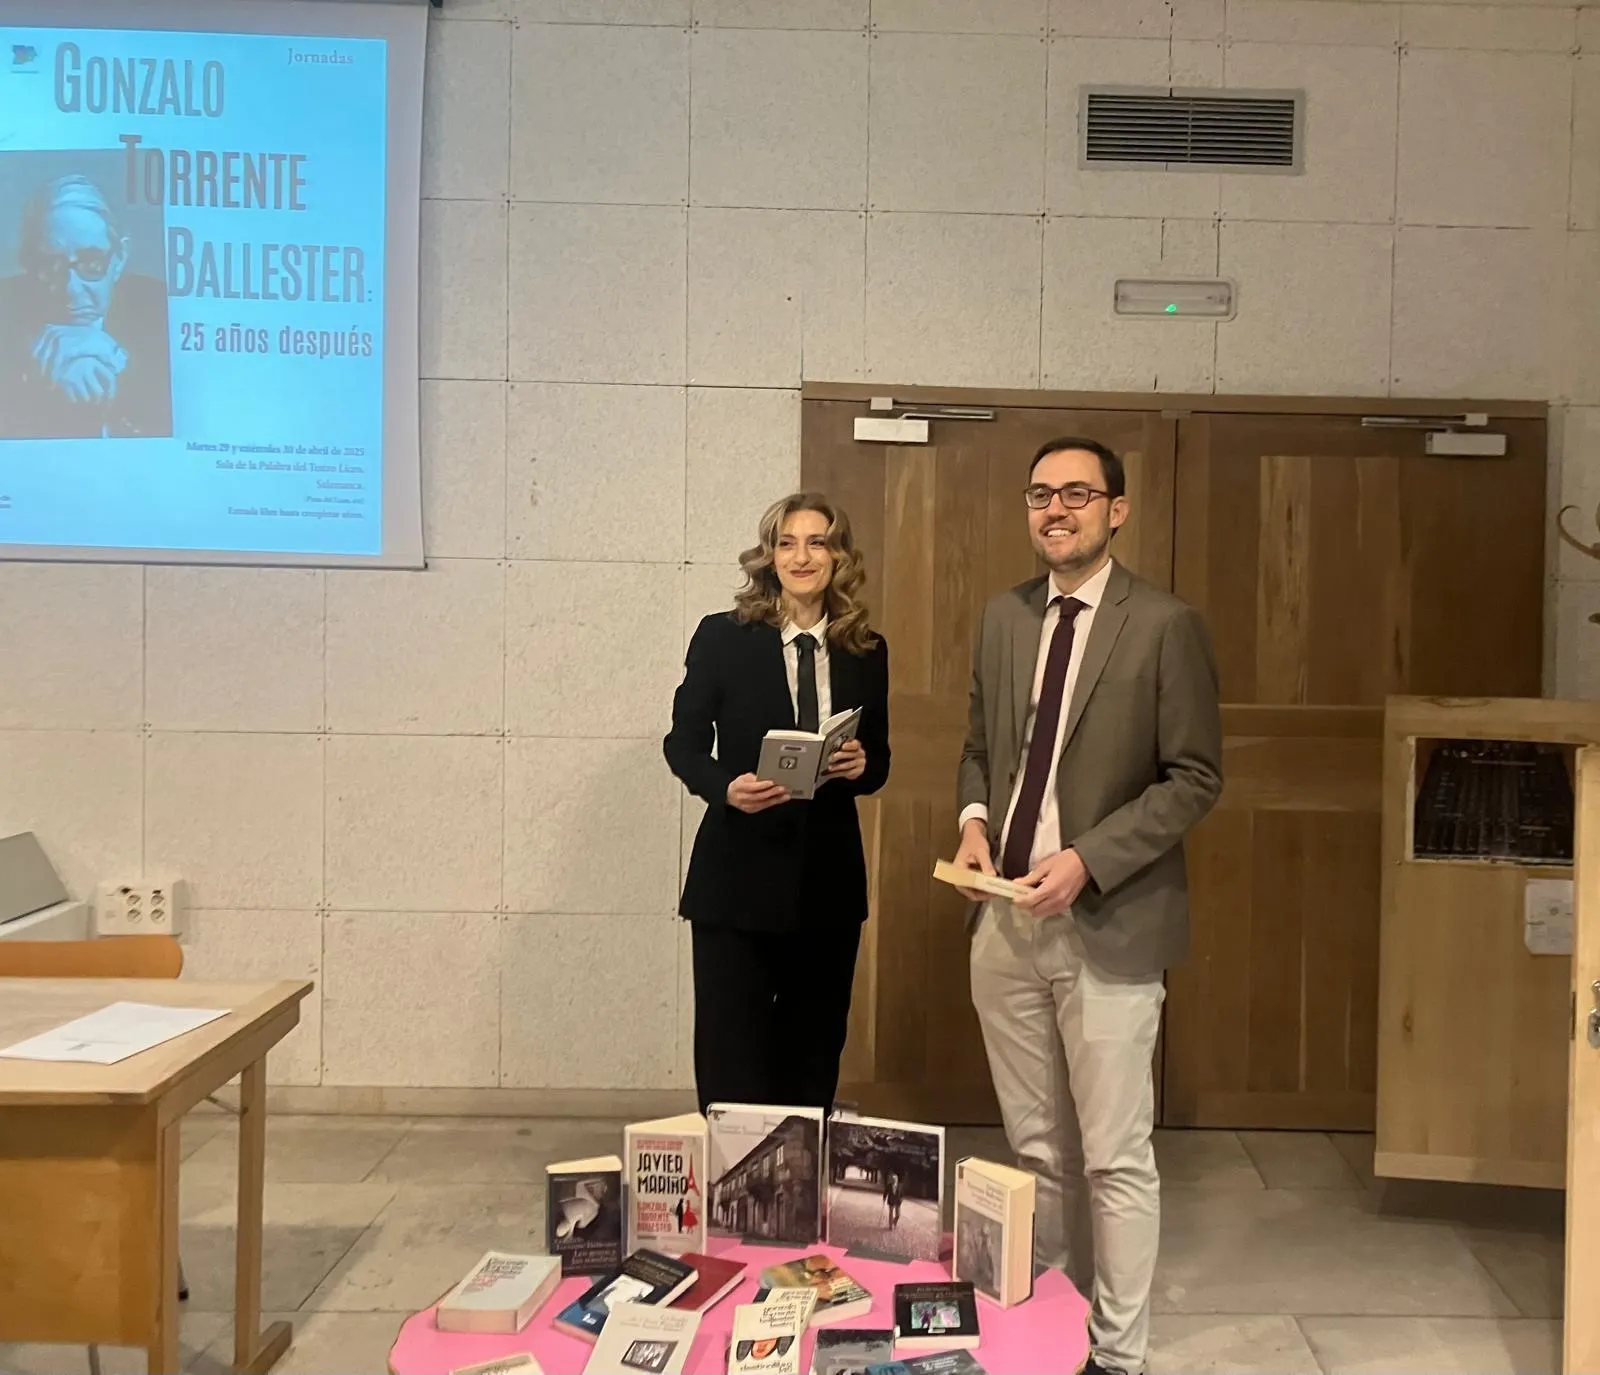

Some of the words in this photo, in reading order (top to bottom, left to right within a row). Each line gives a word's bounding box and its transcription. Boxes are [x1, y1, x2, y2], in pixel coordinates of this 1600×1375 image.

[287, 47, 354, 66] Jornadas
[54, 42, 225, 118] GONZALO
[119, 134, 307, 211] TORRENTE
[167, 226, 373, 303] BALLESTER:
[180, 321, 205, 353] 25
[214, 323, 269, 354] años
[279, 325, 373, 360] después
[308, 445, 329, 456] abril
[636, 1152, 684, 1174] JAVIER
[637, 1175, 690, 1196] MARIÑO
